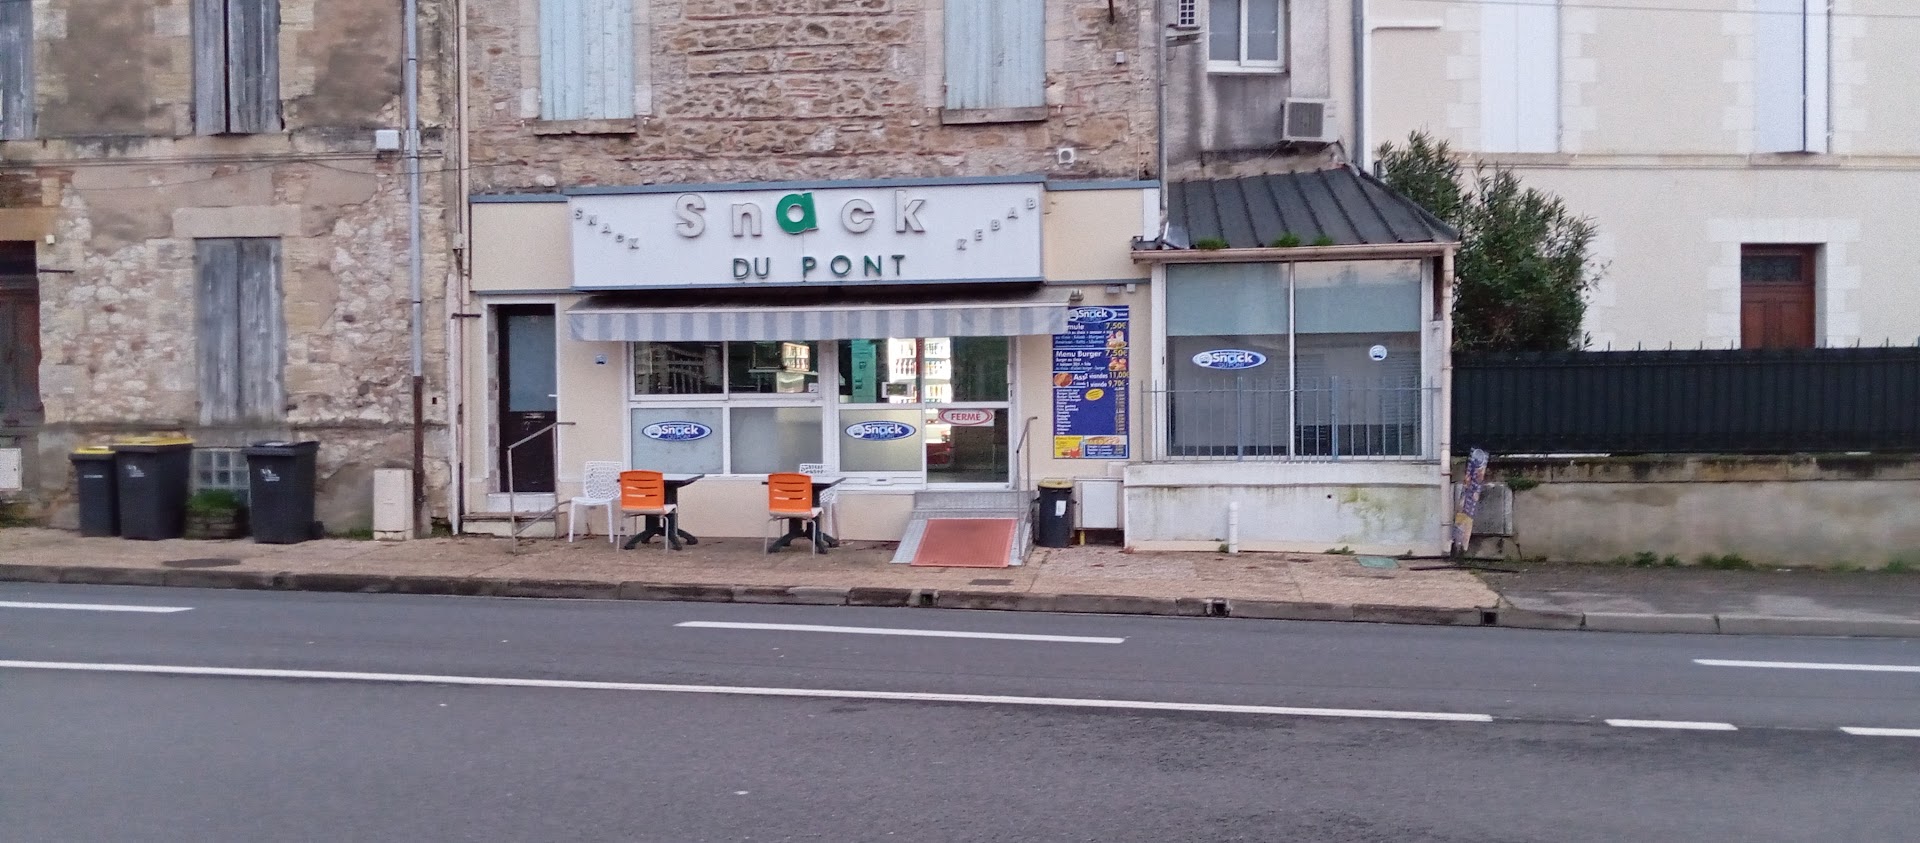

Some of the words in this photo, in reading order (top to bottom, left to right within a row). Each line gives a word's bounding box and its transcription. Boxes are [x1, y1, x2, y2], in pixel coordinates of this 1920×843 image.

[676, 189, 925, 238] Snack
[574, 207, 640, 250] SNACK
[956, 197, 1037, 251] KEBAB
[732, 257, 771, 280] DU
[802, 254, 906, 279] PONT
[1078, 308, 1108, 318] Snack
[1077, 350, 1102, 359] Burger
[1212, 352, 1253, 362] Snack
[661, 424, 699, 434] Snack
[865, 423, 903, 434] Snack
